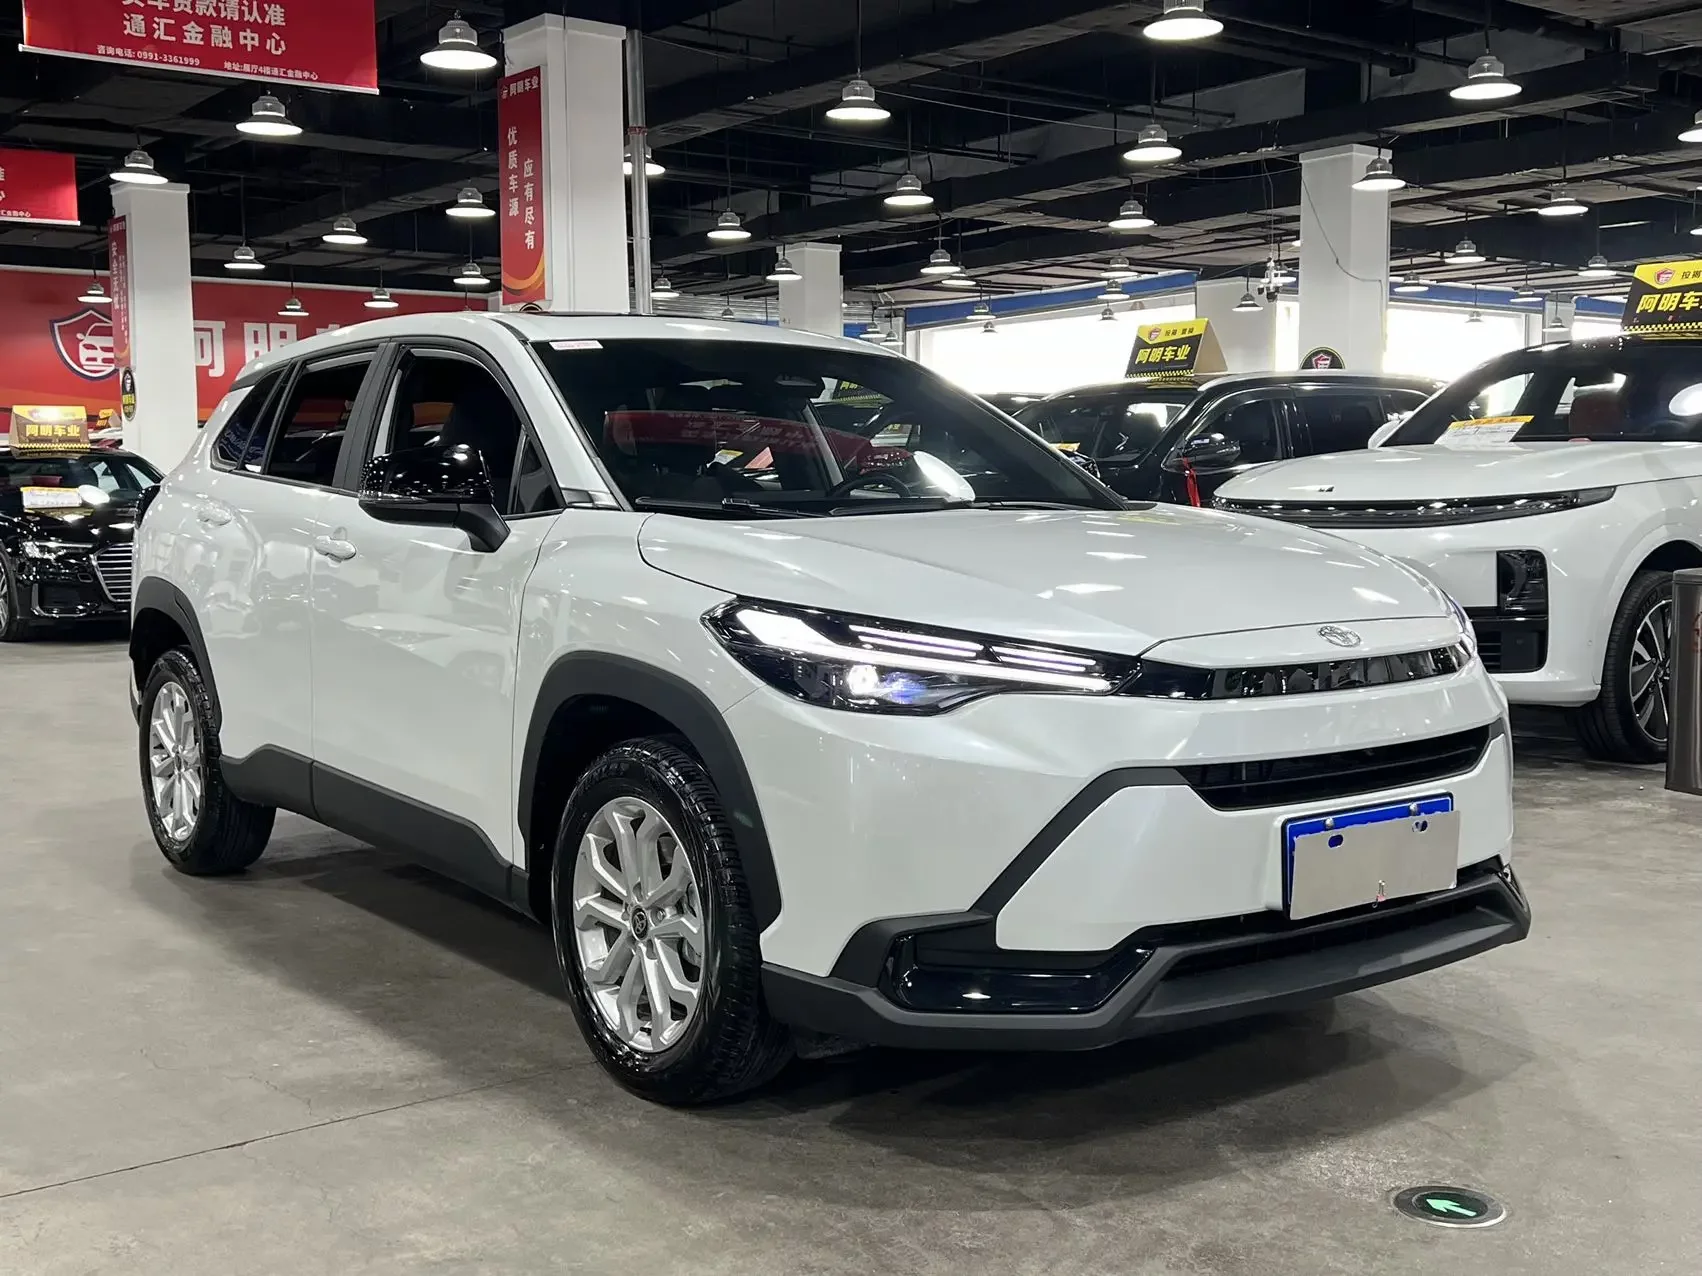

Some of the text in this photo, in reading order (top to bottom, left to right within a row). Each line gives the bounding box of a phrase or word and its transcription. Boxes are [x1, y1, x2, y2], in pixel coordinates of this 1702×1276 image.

[123, 13, 286, 55] 通汇金融中心
[508, 126, 519, 217] 优质车源
[524, 158, 536, 250] 应有尽有
[1636, 291, 1702, 313] 阿明车
[1135, 344, 1191, 364] 阿明车业
[26, 424, 80, 437] 阿明车业
